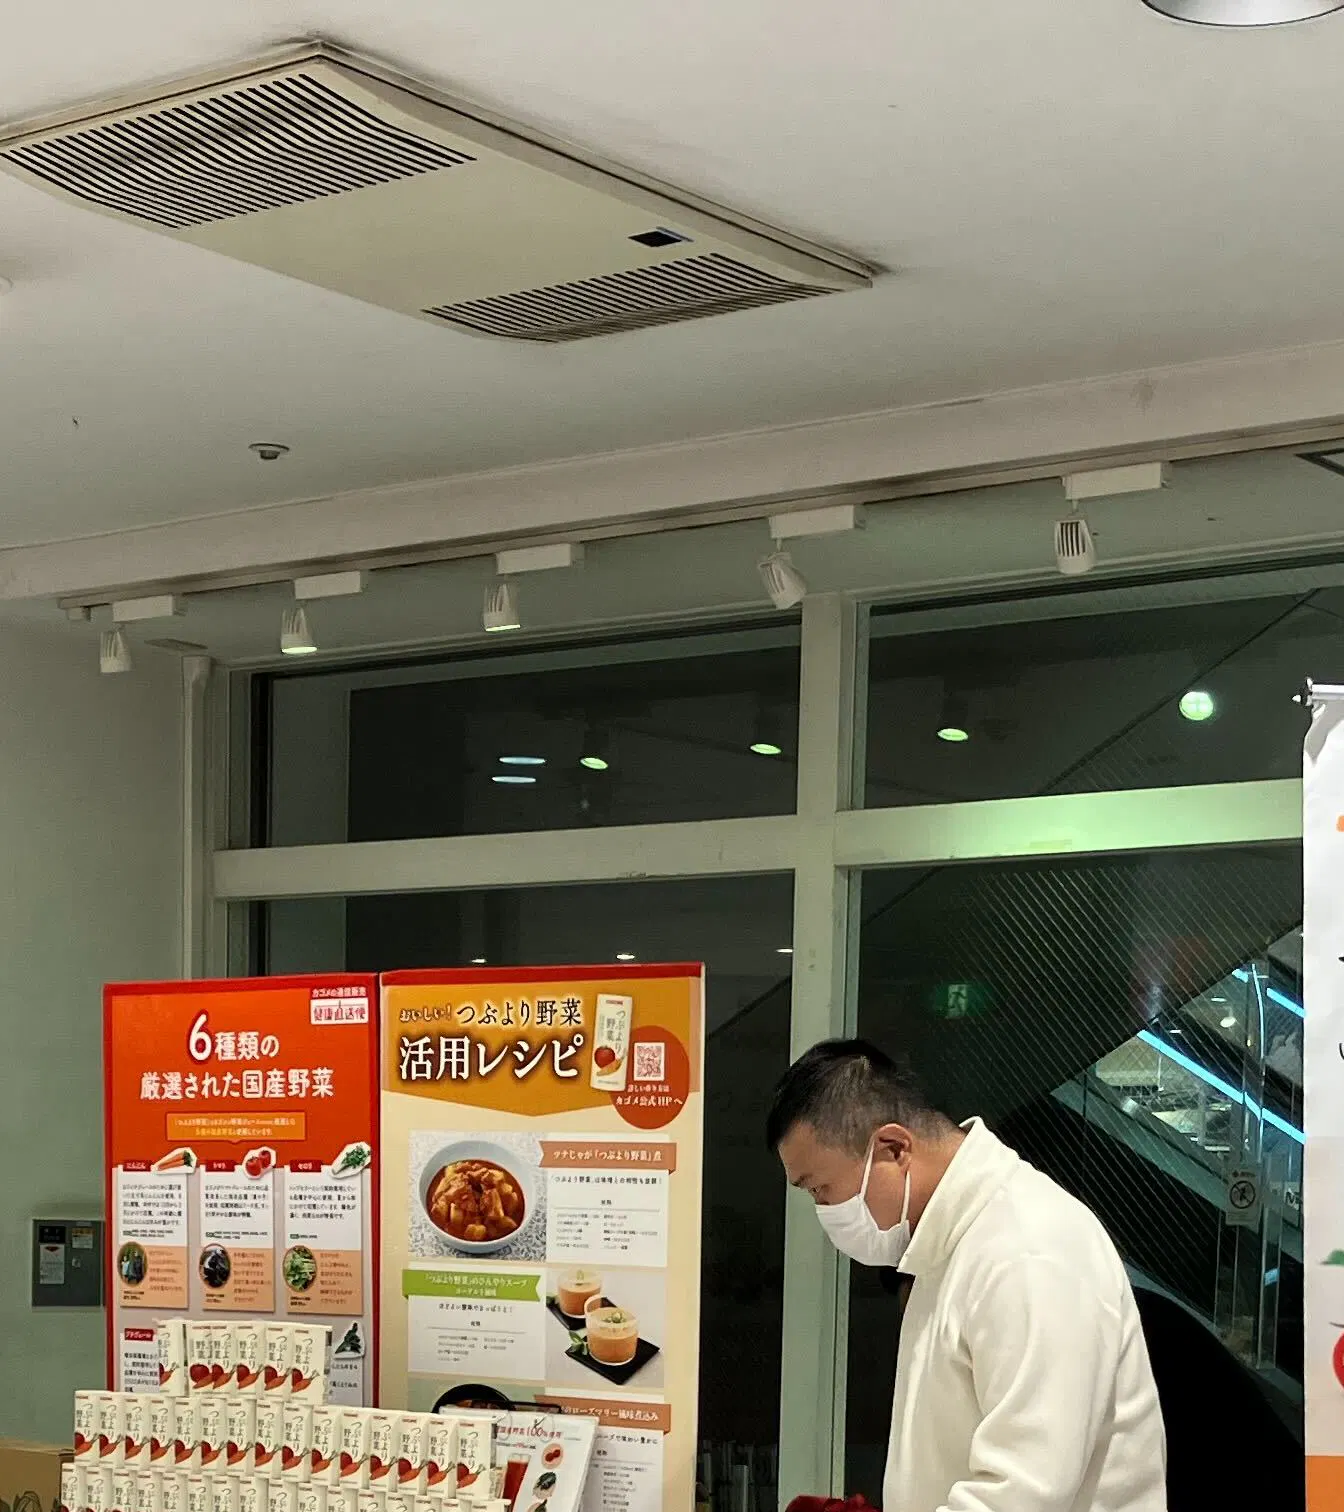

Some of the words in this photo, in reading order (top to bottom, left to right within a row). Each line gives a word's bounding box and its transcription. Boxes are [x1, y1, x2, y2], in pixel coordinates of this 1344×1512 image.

[456, 998, 583, 1027] つぶより野菜
[189, 1013, 280, 1061] 6種類の
[399, 1033, 584, 1081] 活用レシピ
[140, 1066, 334, 1101] 厳選された国産野菜
